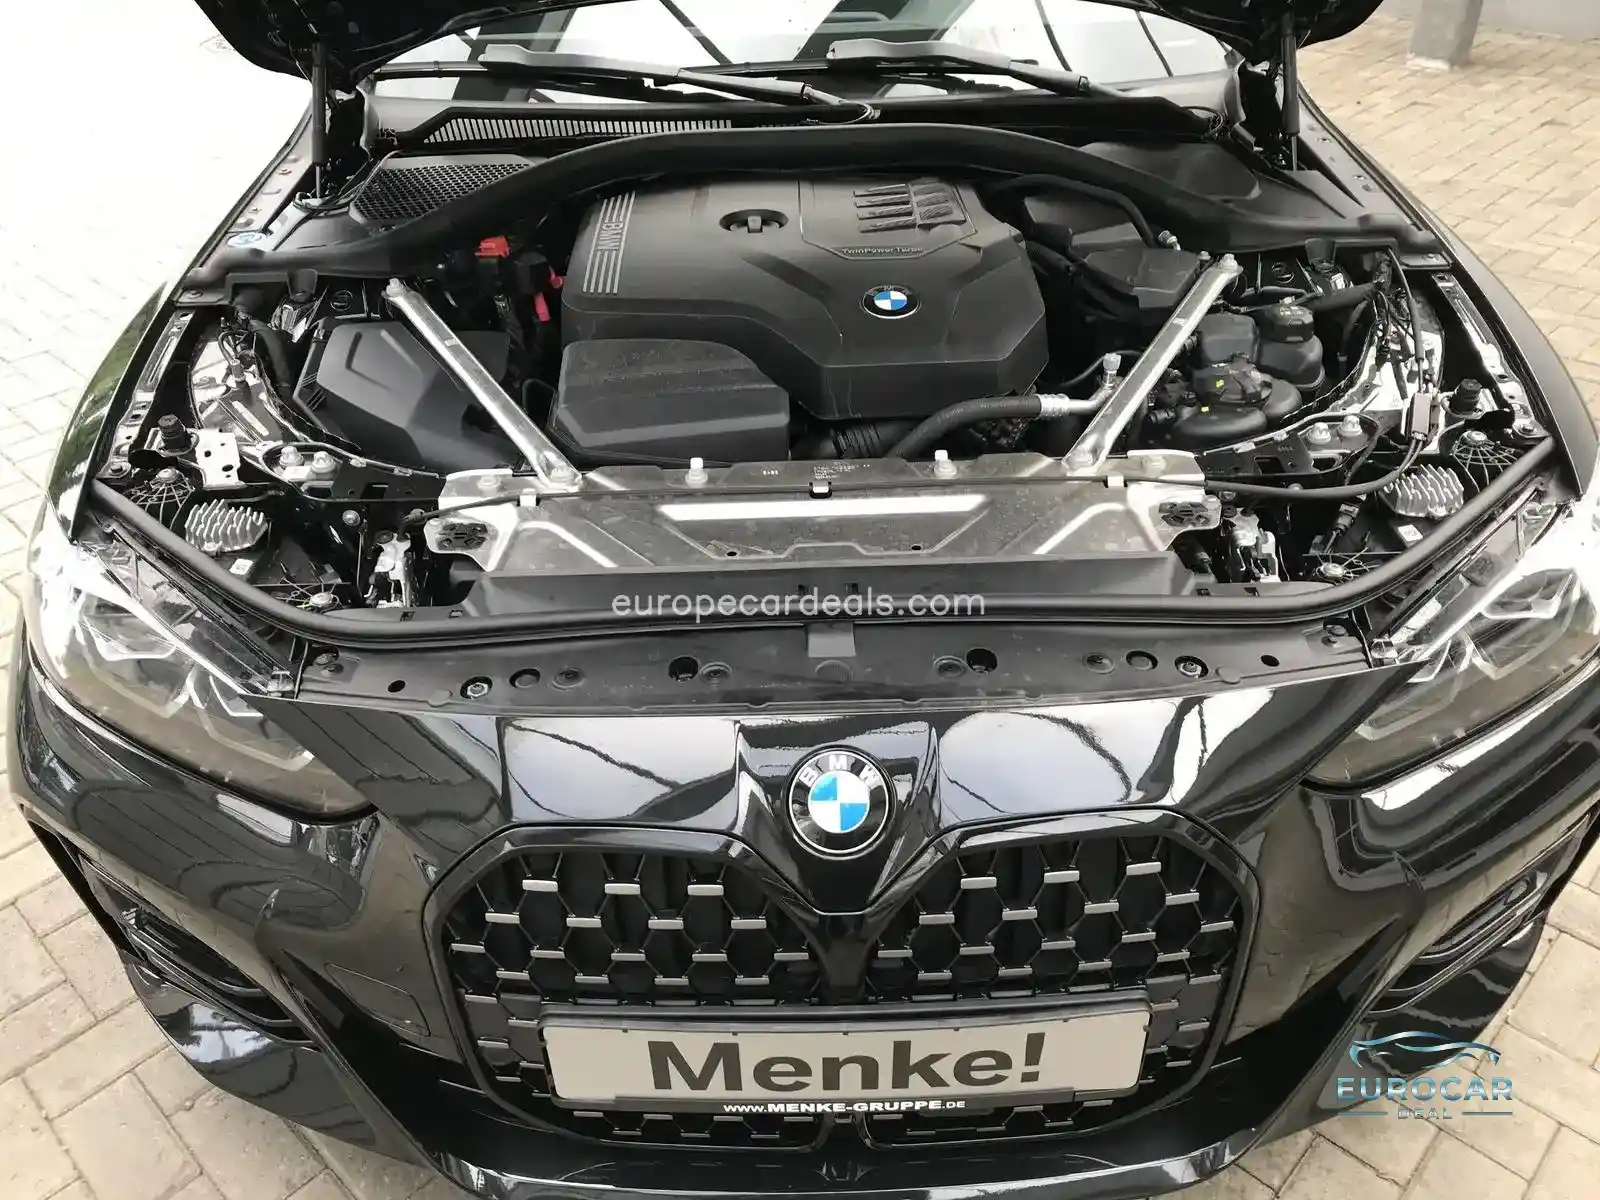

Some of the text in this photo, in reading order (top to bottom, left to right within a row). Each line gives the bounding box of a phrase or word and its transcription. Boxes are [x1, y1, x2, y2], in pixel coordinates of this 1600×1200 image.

[597, 221, 624, 250] BMW
[798, 754, 884, 791] BMW
[647, 1031, 1046, 1092] Menke!
[723, 1100, 966, 1114] www.MENKE-GRUPPE.DE
